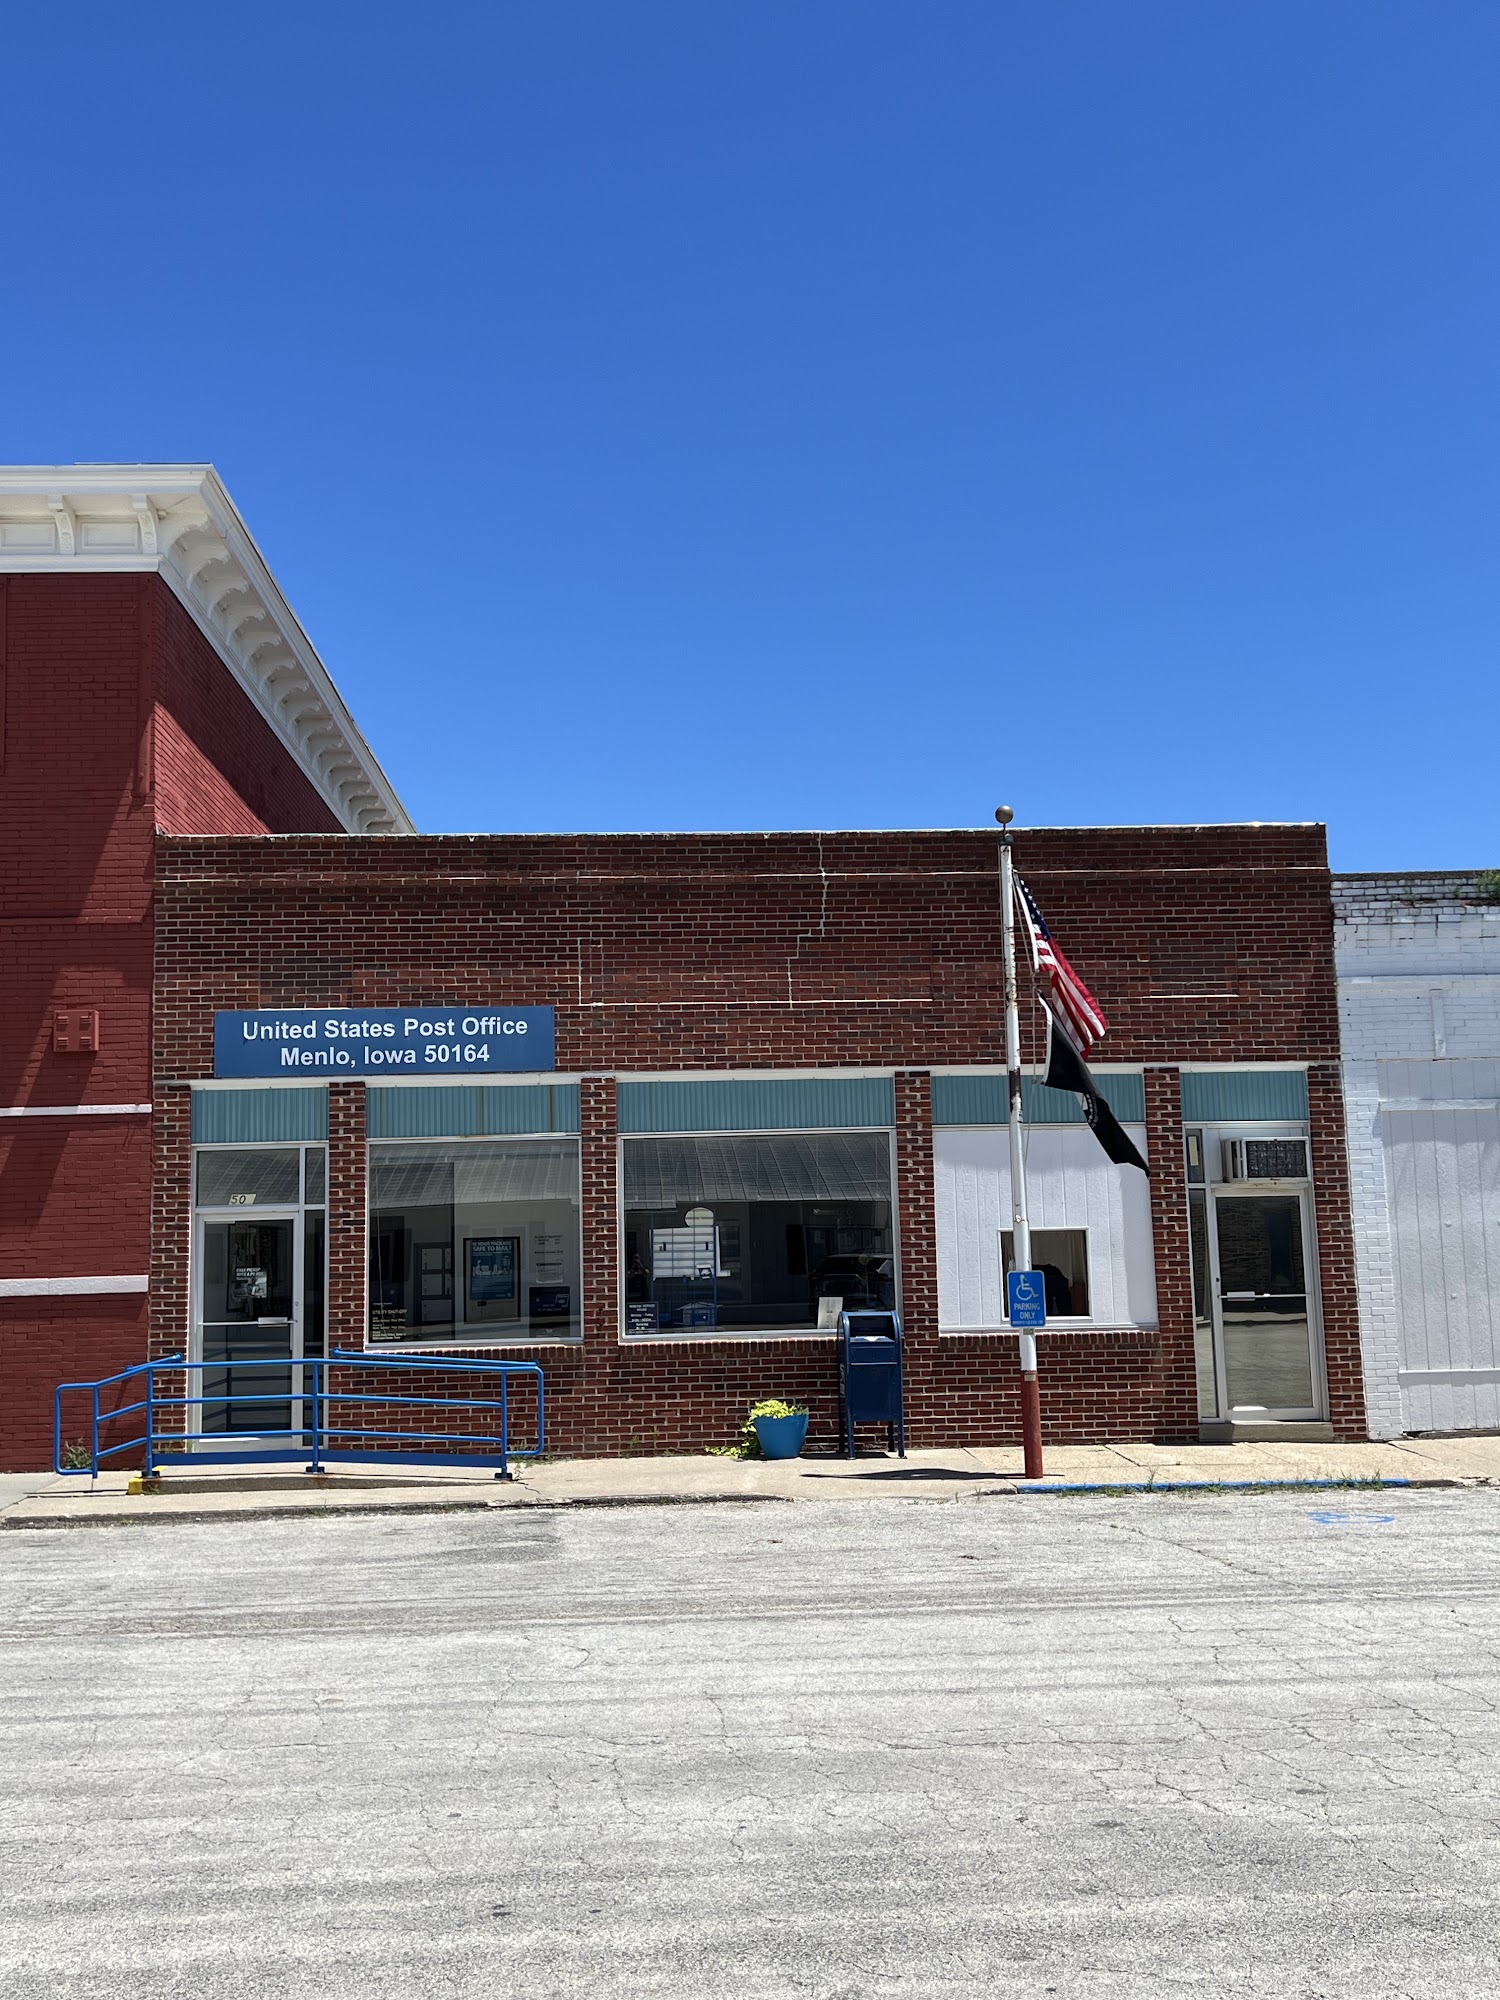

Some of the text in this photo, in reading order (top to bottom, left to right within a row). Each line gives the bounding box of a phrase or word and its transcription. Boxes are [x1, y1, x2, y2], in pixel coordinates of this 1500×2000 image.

[242, 1016, 528, 1040] United States Post Office
[280, 1043, 490, 1068] Menlo, Iowa 50164
[231, 1195, 246, 1204] 50
[1014, 1302, 1040, 1311] PARKING
[1020, 1311, 1035, 1320] ONLY
